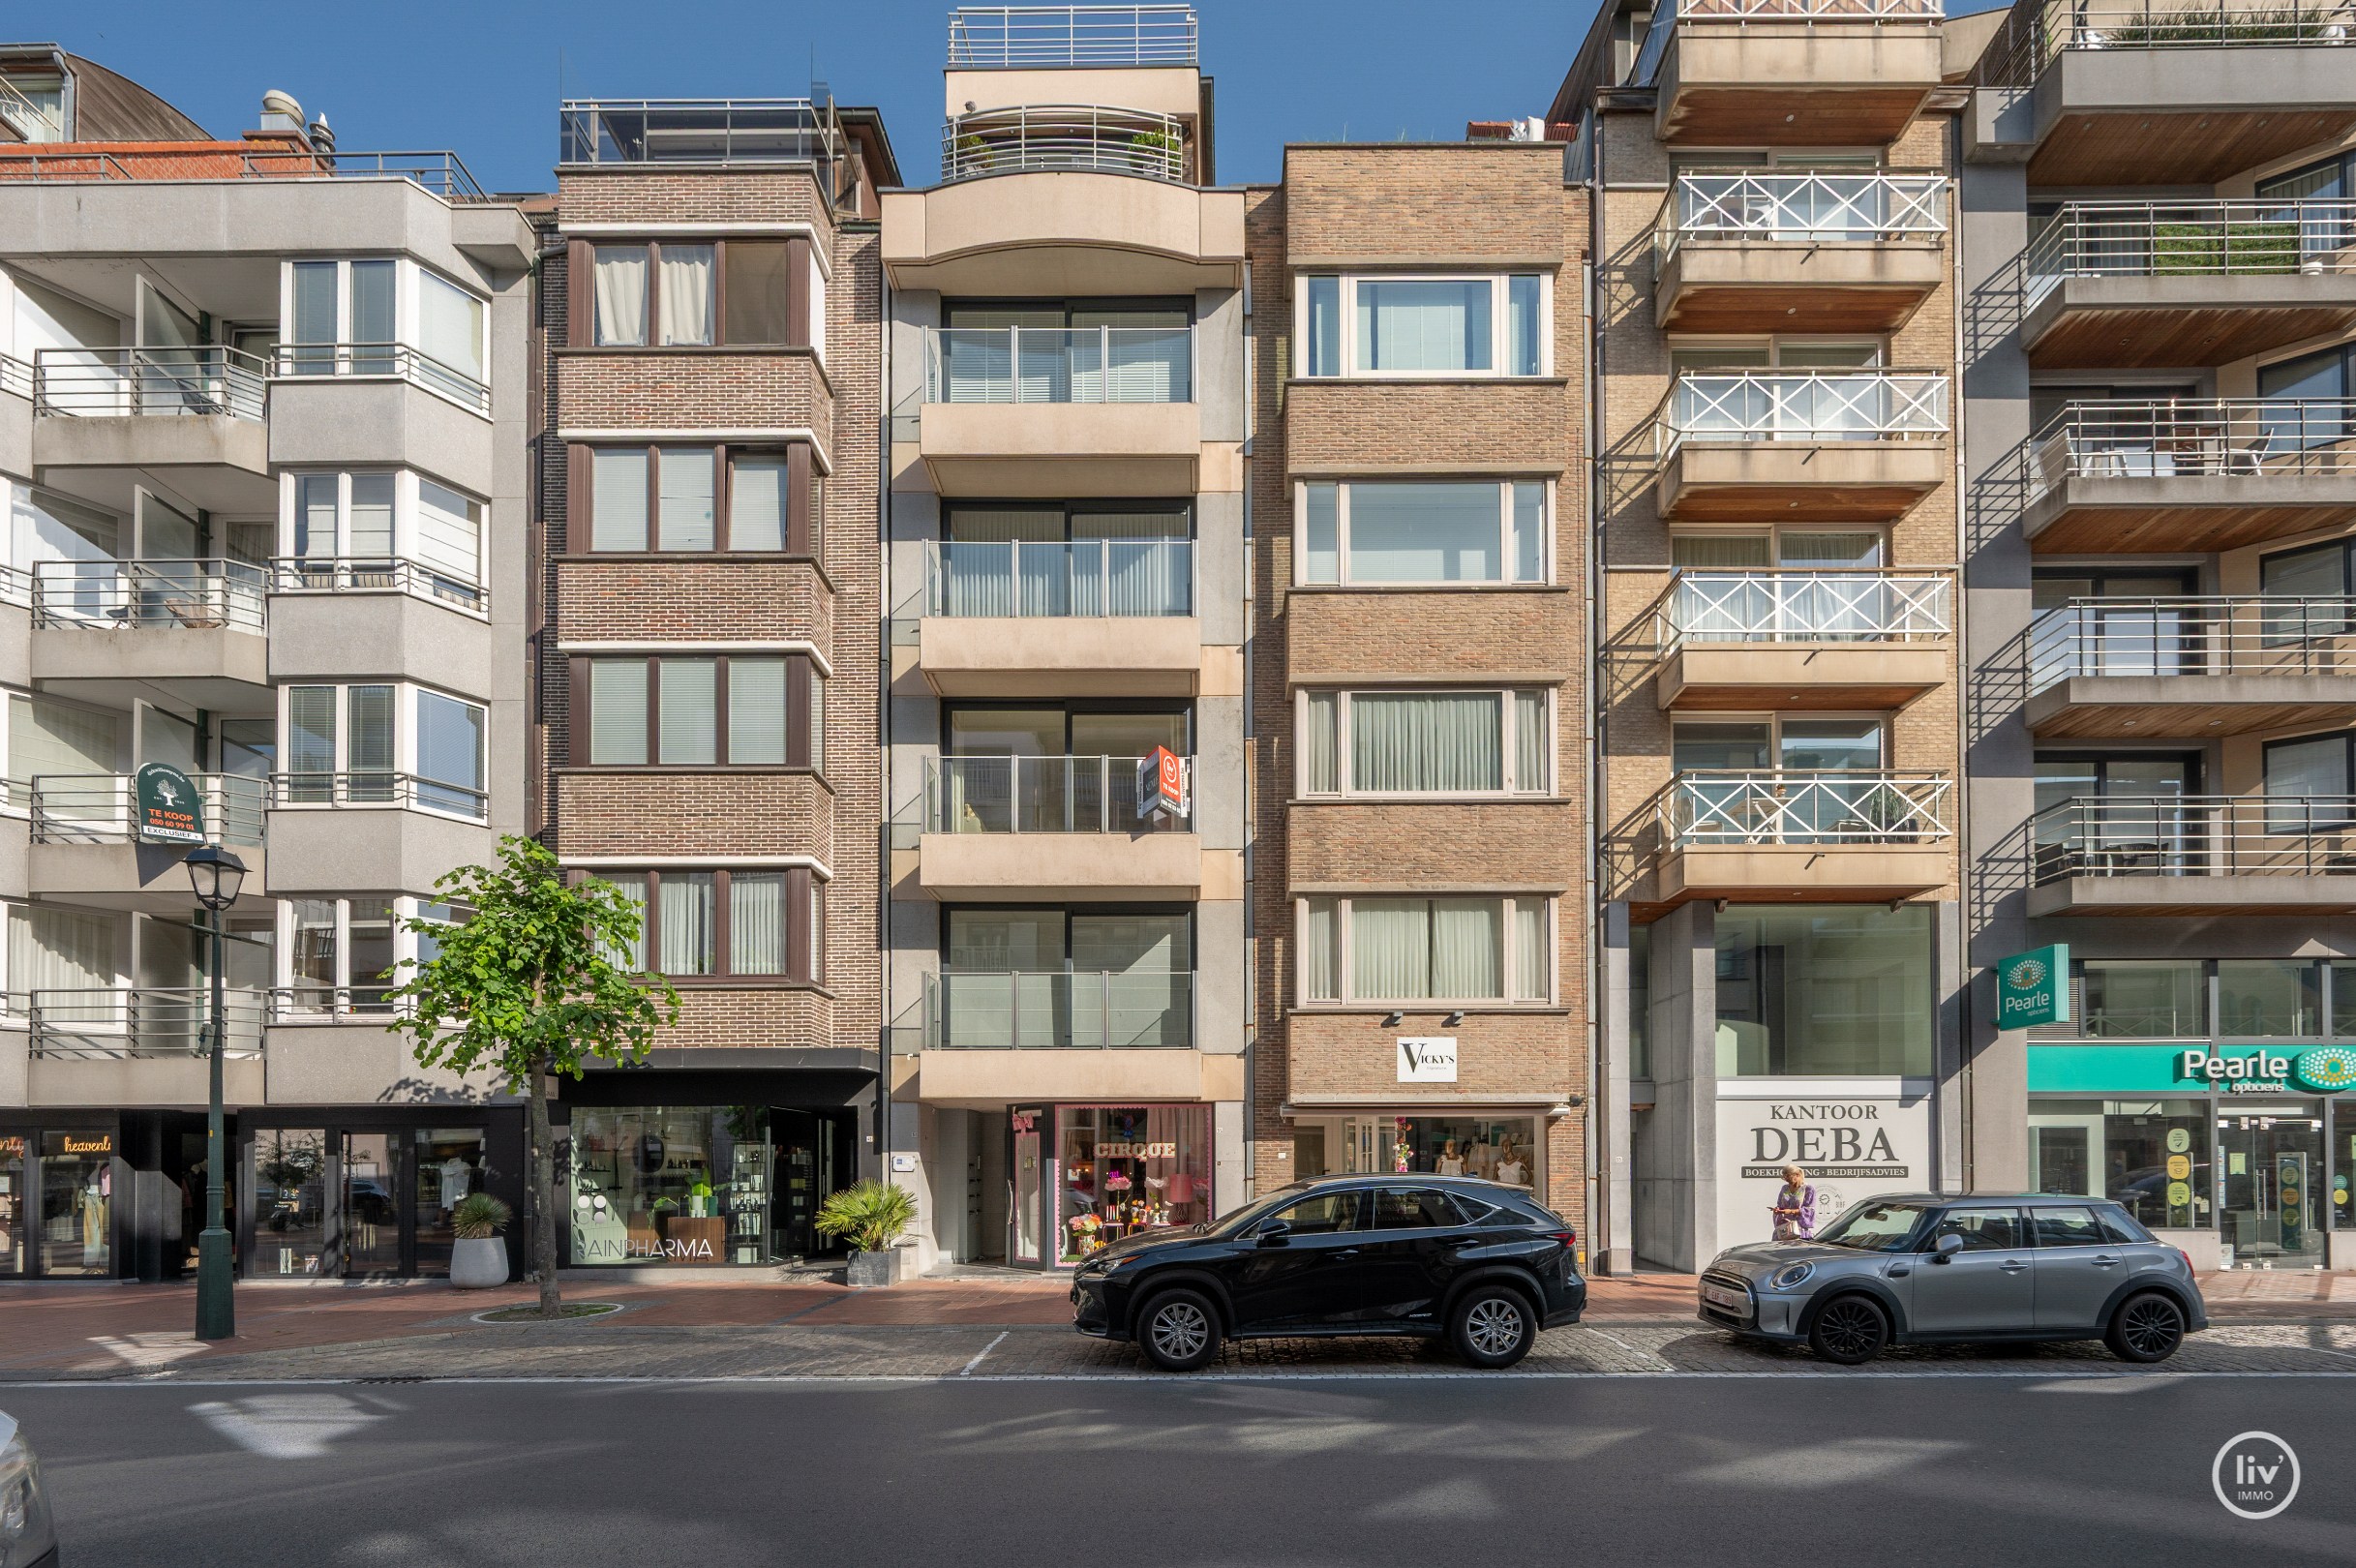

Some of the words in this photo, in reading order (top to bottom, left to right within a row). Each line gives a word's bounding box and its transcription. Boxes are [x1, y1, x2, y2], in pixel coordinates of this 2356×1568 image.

[148, 808, 163, 818] TE
[164, 811, 194, 822] KOOP
[147, 827, 192, 838] EXCLUSIEF
[2006, 990, 2050, 1013] Pearle
[2027, 1008, 2050, 1016] opticiens
[2184, 1049, 2288, 1078] Pearle
[2232, 1081, 2285, 1095] opticiens
[1770, 1104, 1880, 1120] KANTOOR
[1094, 1142, 1176, 1161] CIRQUE
[1750, 1127, 1900, 1162] DEBA
[1745, 1168, 1820, 1177] BOEKHNG
[1827, 1168, 1905, 1178] BEDRIJFSADVIES
[577, 1239, 713, 1257] RAINPHARMA
